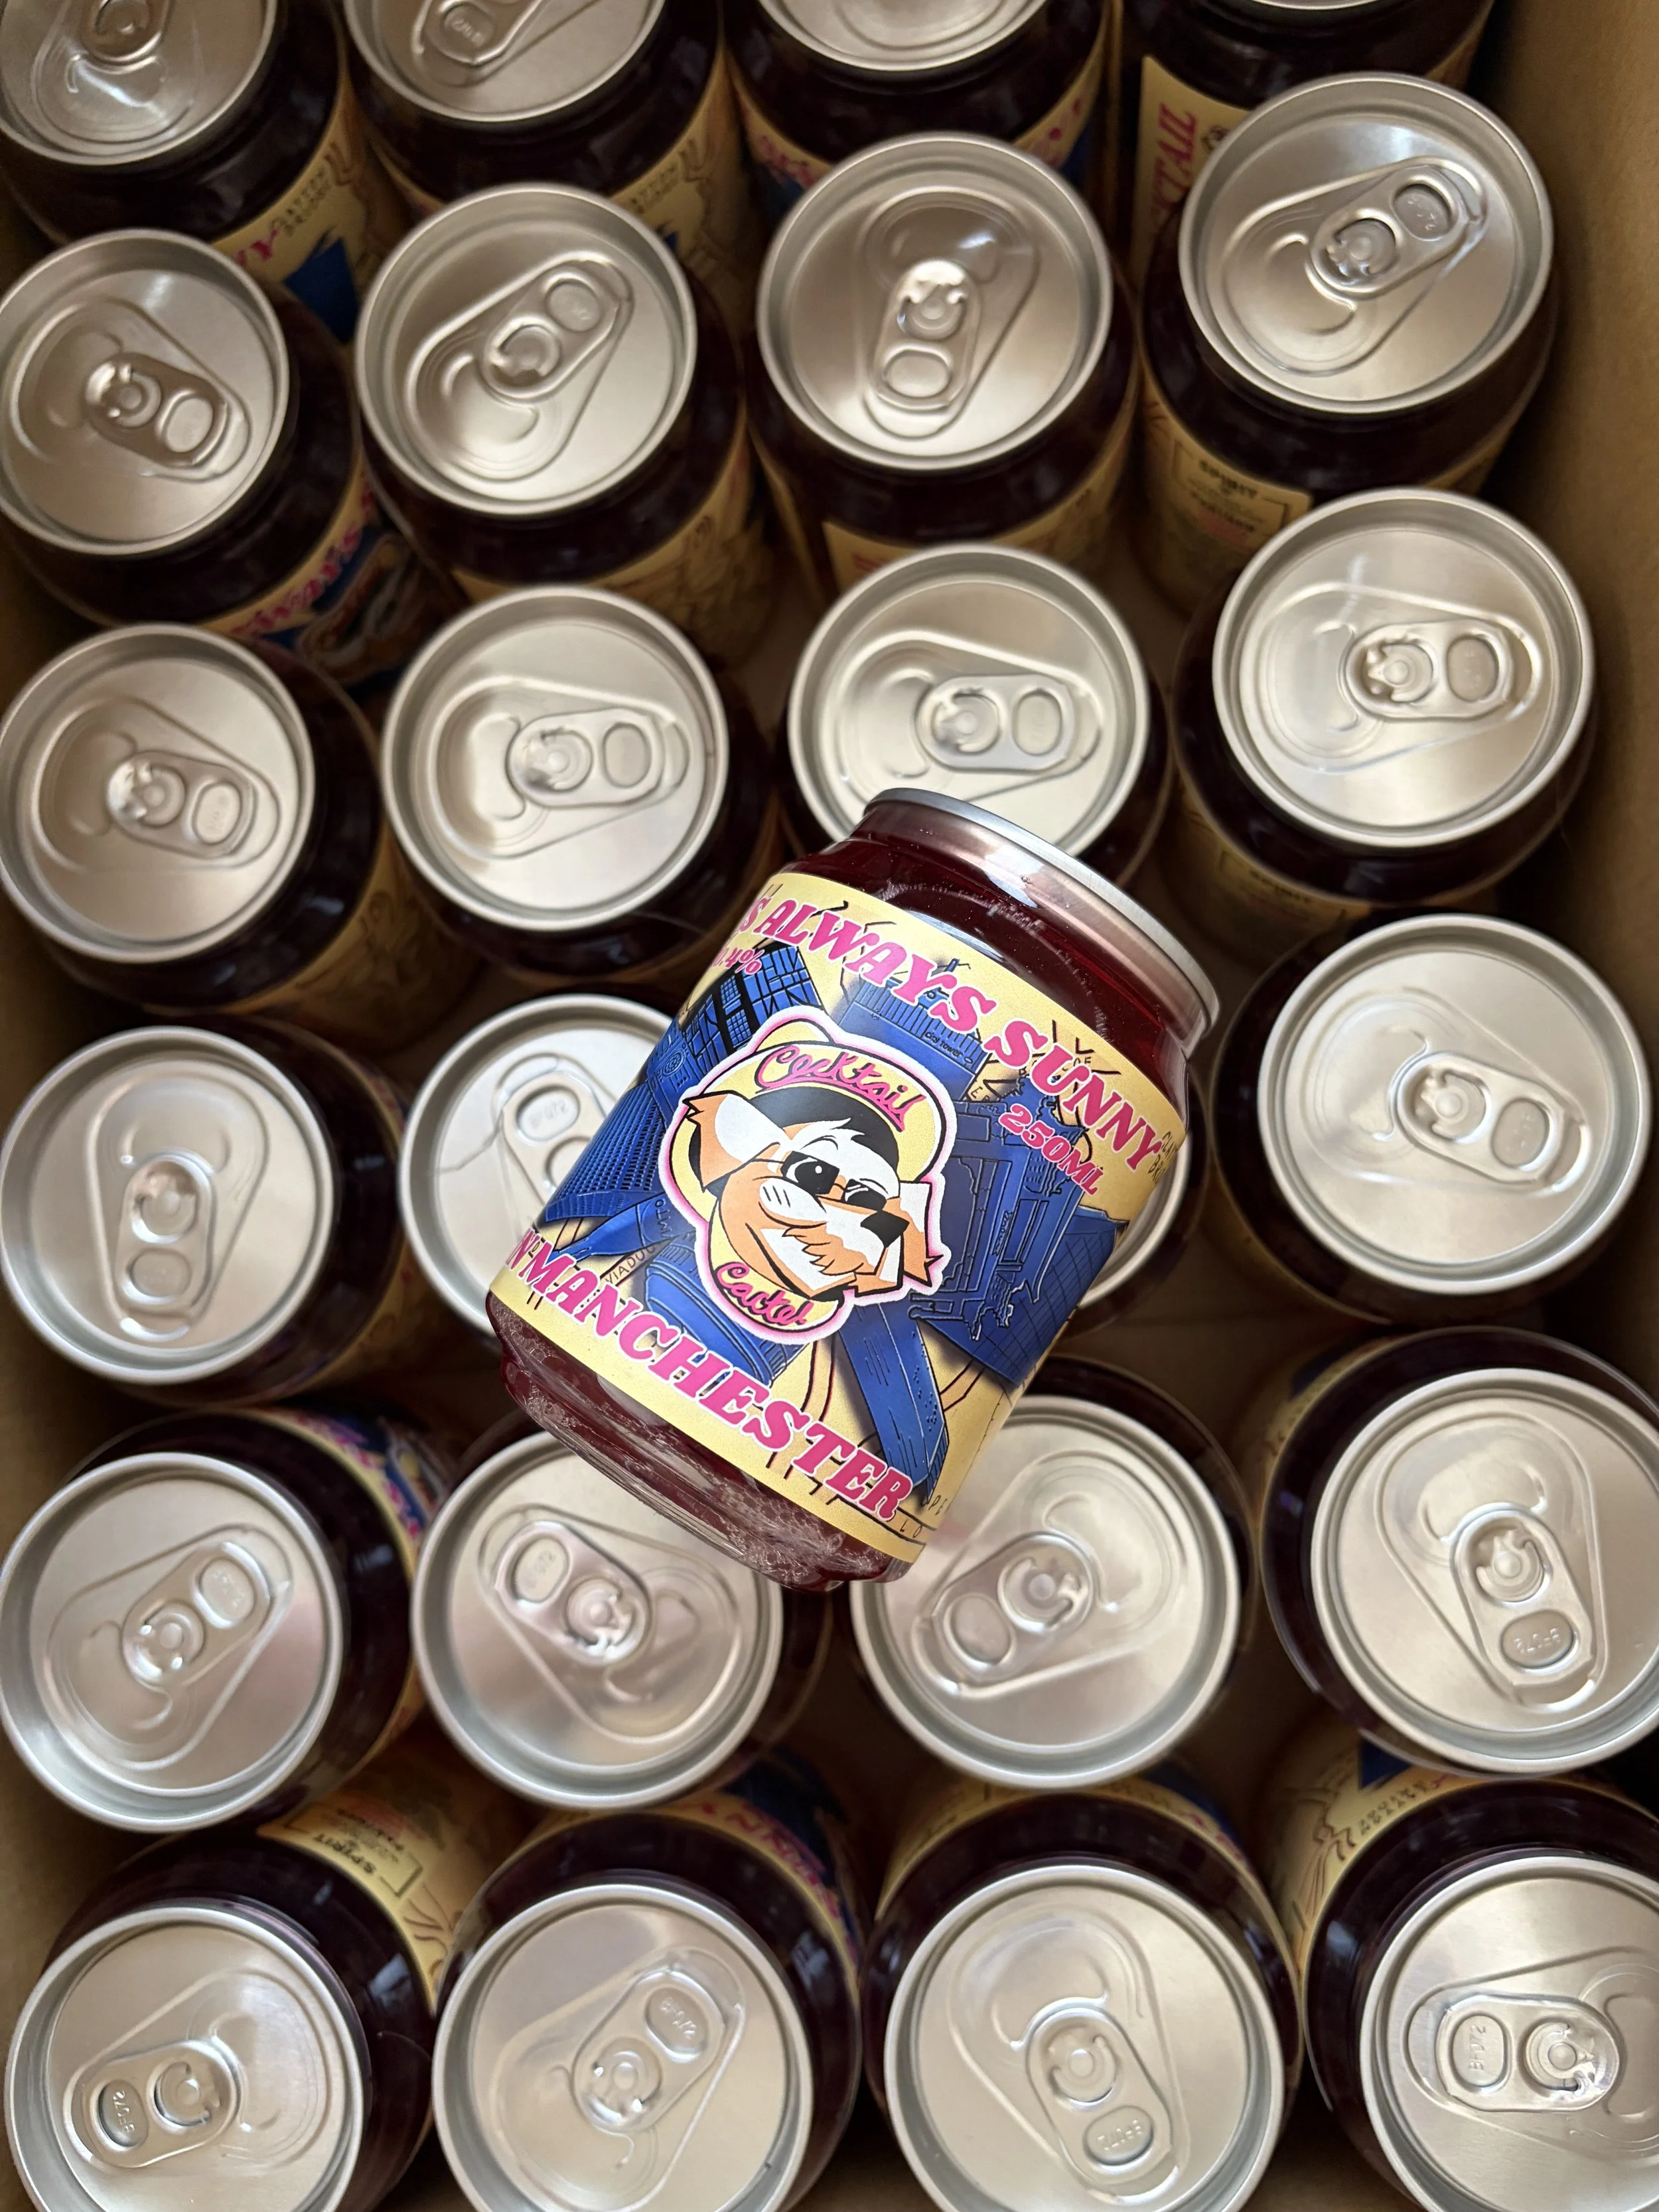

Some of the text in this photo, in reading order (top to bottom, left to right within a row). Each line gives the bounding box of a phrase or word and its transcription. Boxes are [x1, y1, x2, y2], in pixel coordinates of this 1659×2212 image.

[753, 899, 997, 1033] ALWAYS
[982, 1019, 1163, 1171] SUNNY
[755, 1045, 927, 1132] Cocktail
[998, 1103, 1104, 1195] 250ML
[518, 1240, 913, 1520] MANCHESTER
